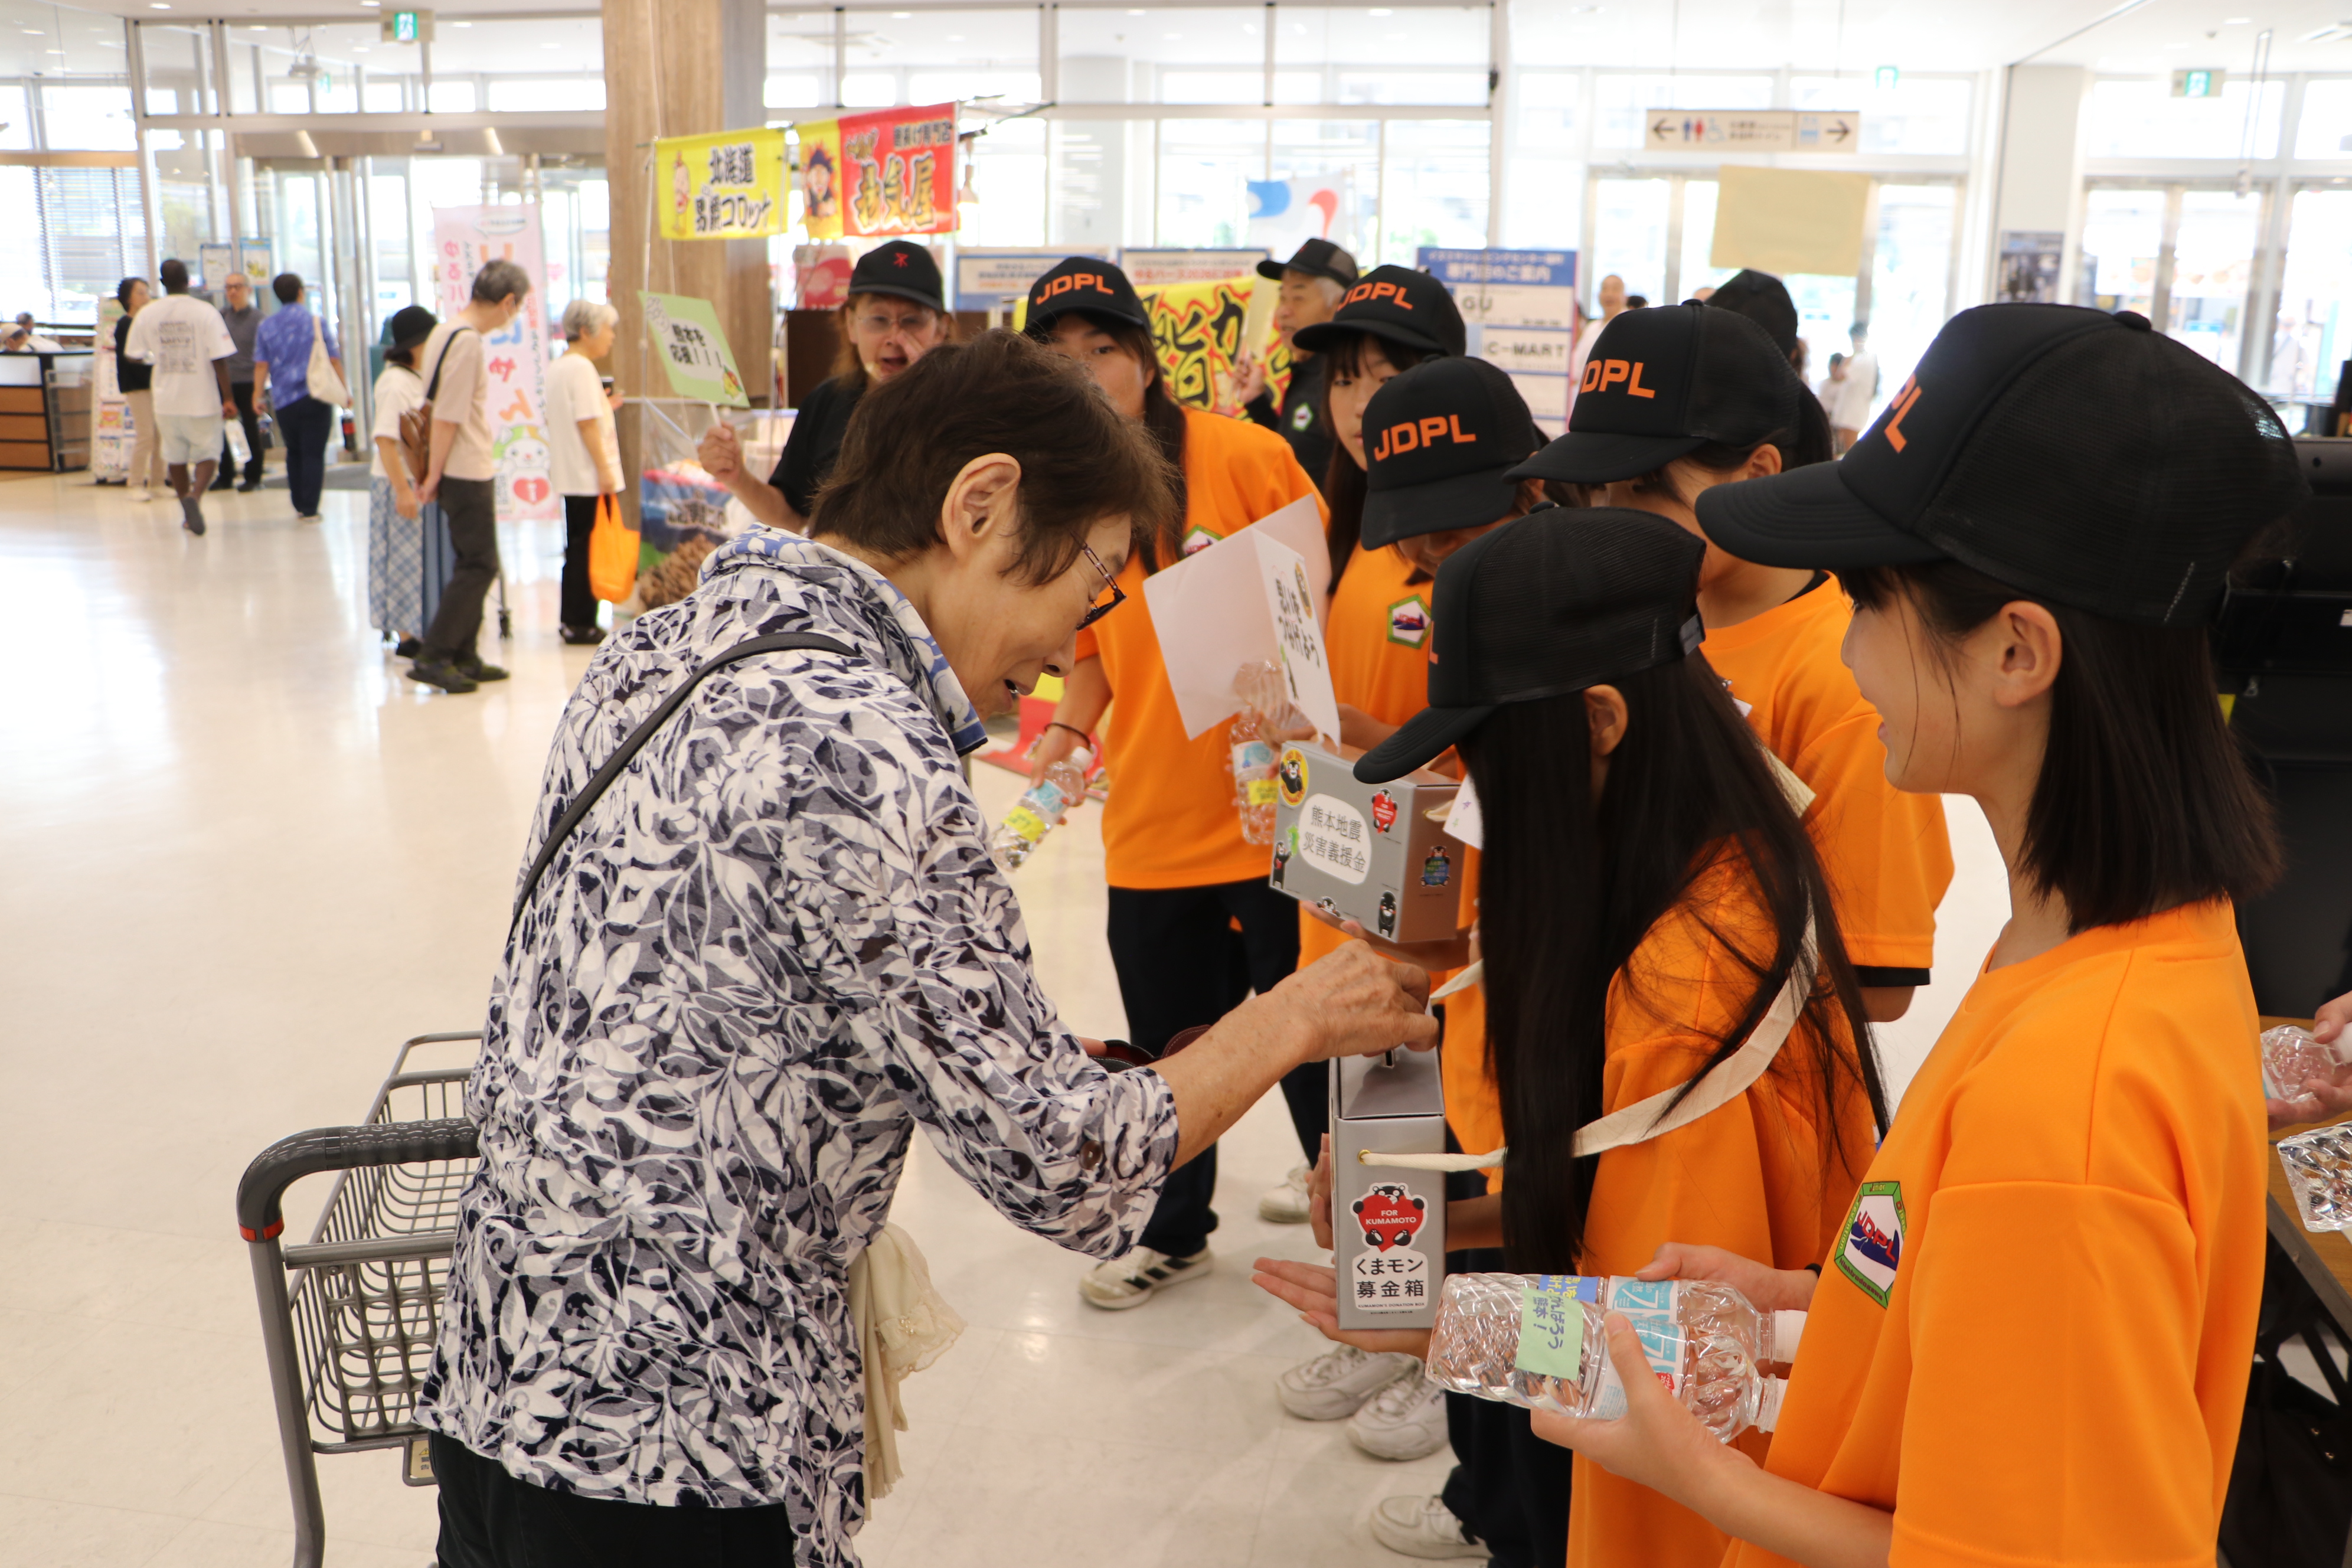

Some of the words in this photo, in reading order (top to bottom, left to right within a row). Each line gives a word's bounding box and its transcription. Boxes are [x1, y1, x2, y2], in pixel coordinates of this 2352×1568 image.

[710, 143, 753, 185] 北海道
[1035, 273, 1115, 305] JDPL
[1337, 282, 1413, 311] JDPL
[1579, 358, 1655, 398] DPL
[1373, 414, 1476, 462] JDPL
[1311, 804, 1362, 843] 熊本地震
[1302, 831, 1366, 874] 災害義援金
[1869, 1183, 1886, 1192] Junior
[1366, 1216, 1417, 1225] KUMAMOTO
[1839, 1194, 1863, 1250] Prevention
[1857, 1210, 1896, 1263] JDPL
[1357, 1258, 1423, 1275] くまモン
[1357, 1279, 1424, 1298] 募金箱
[1547, 1296, 1565, 1350] がんばろう
